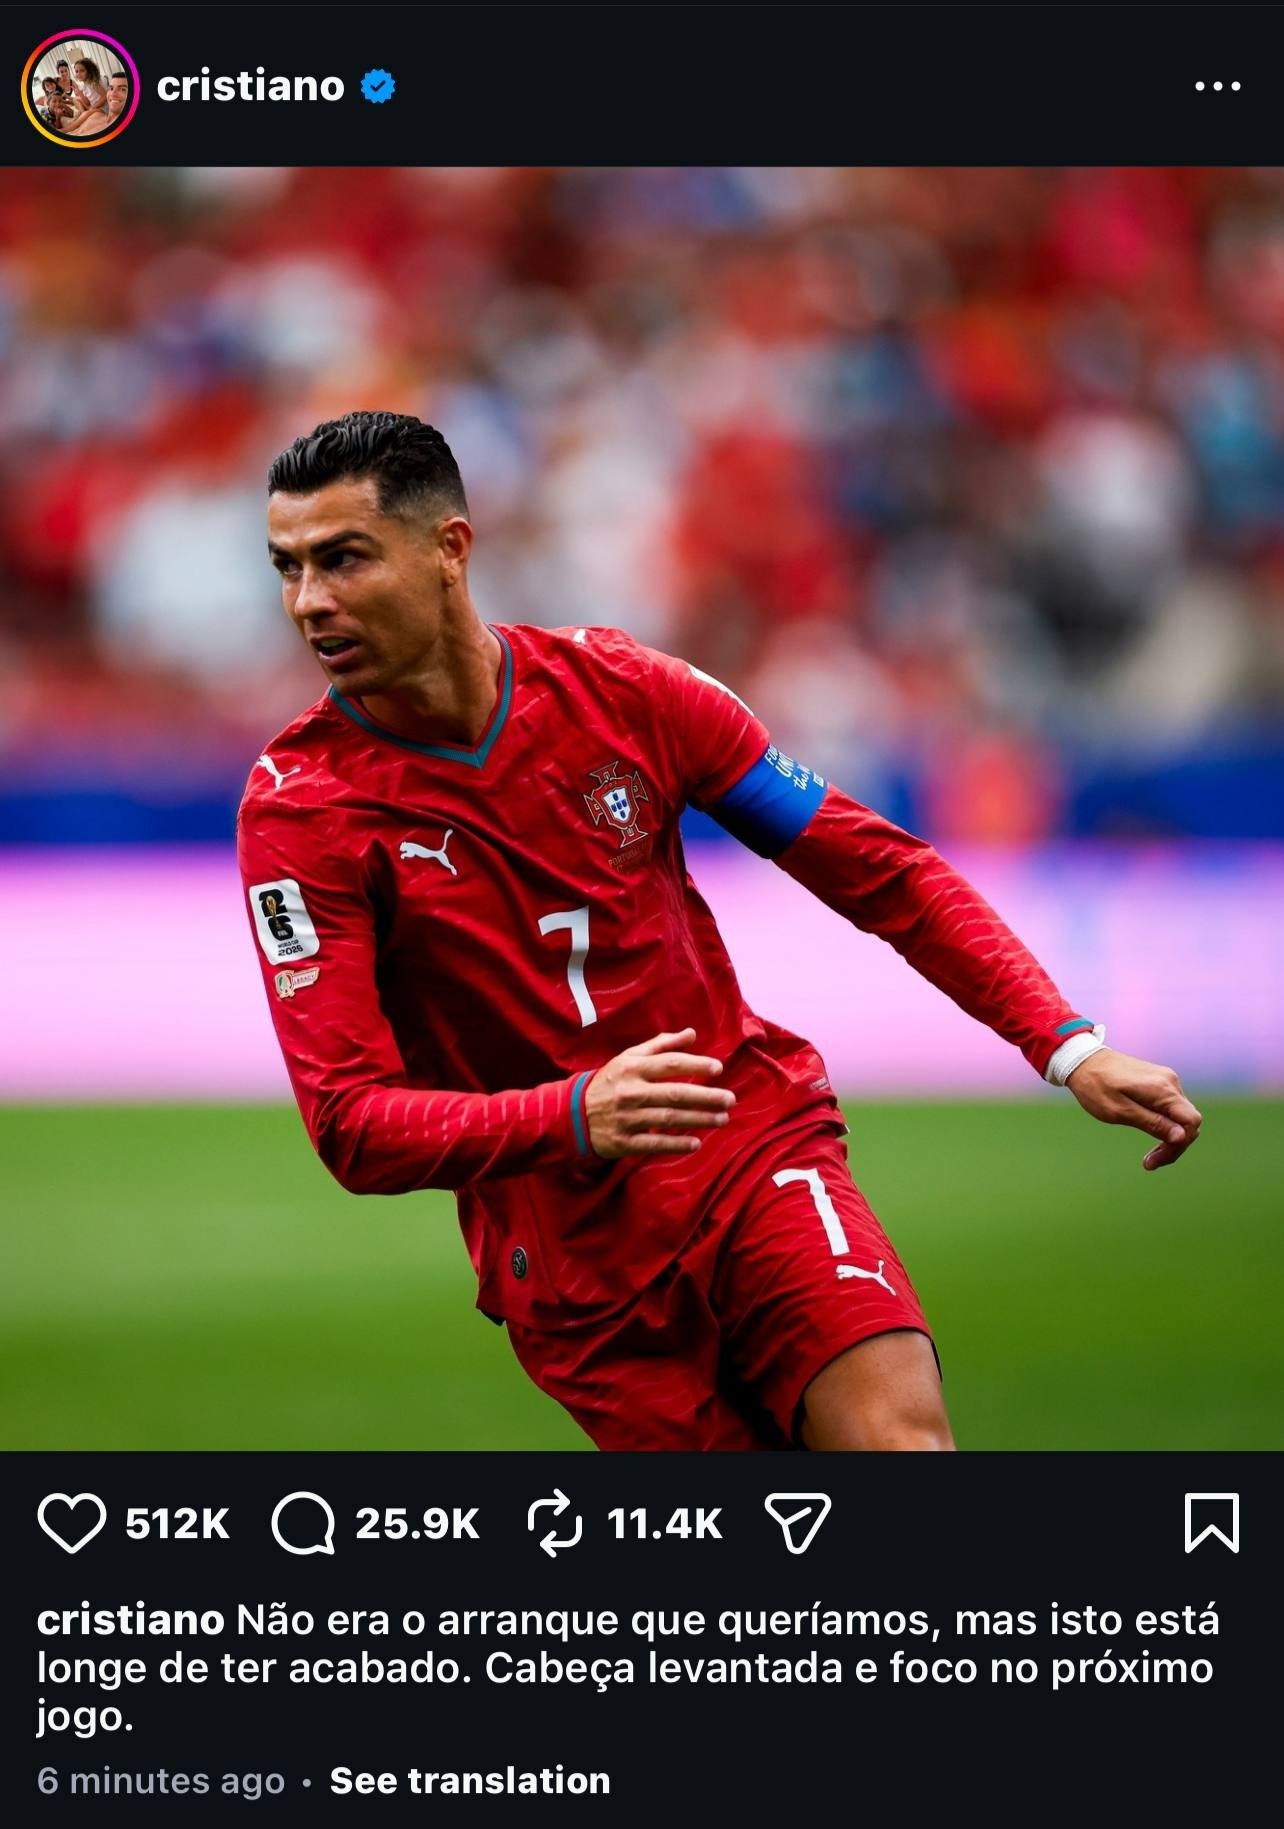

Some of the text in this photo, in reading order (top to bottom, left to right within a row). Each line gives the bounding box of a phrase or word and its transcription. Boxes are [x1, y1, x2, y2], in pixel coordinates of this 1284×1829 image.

[278, 944, 304, 957] 2026
[538, 905, 597, 1028] 7
[772, 1168, 850, 1256] 7
